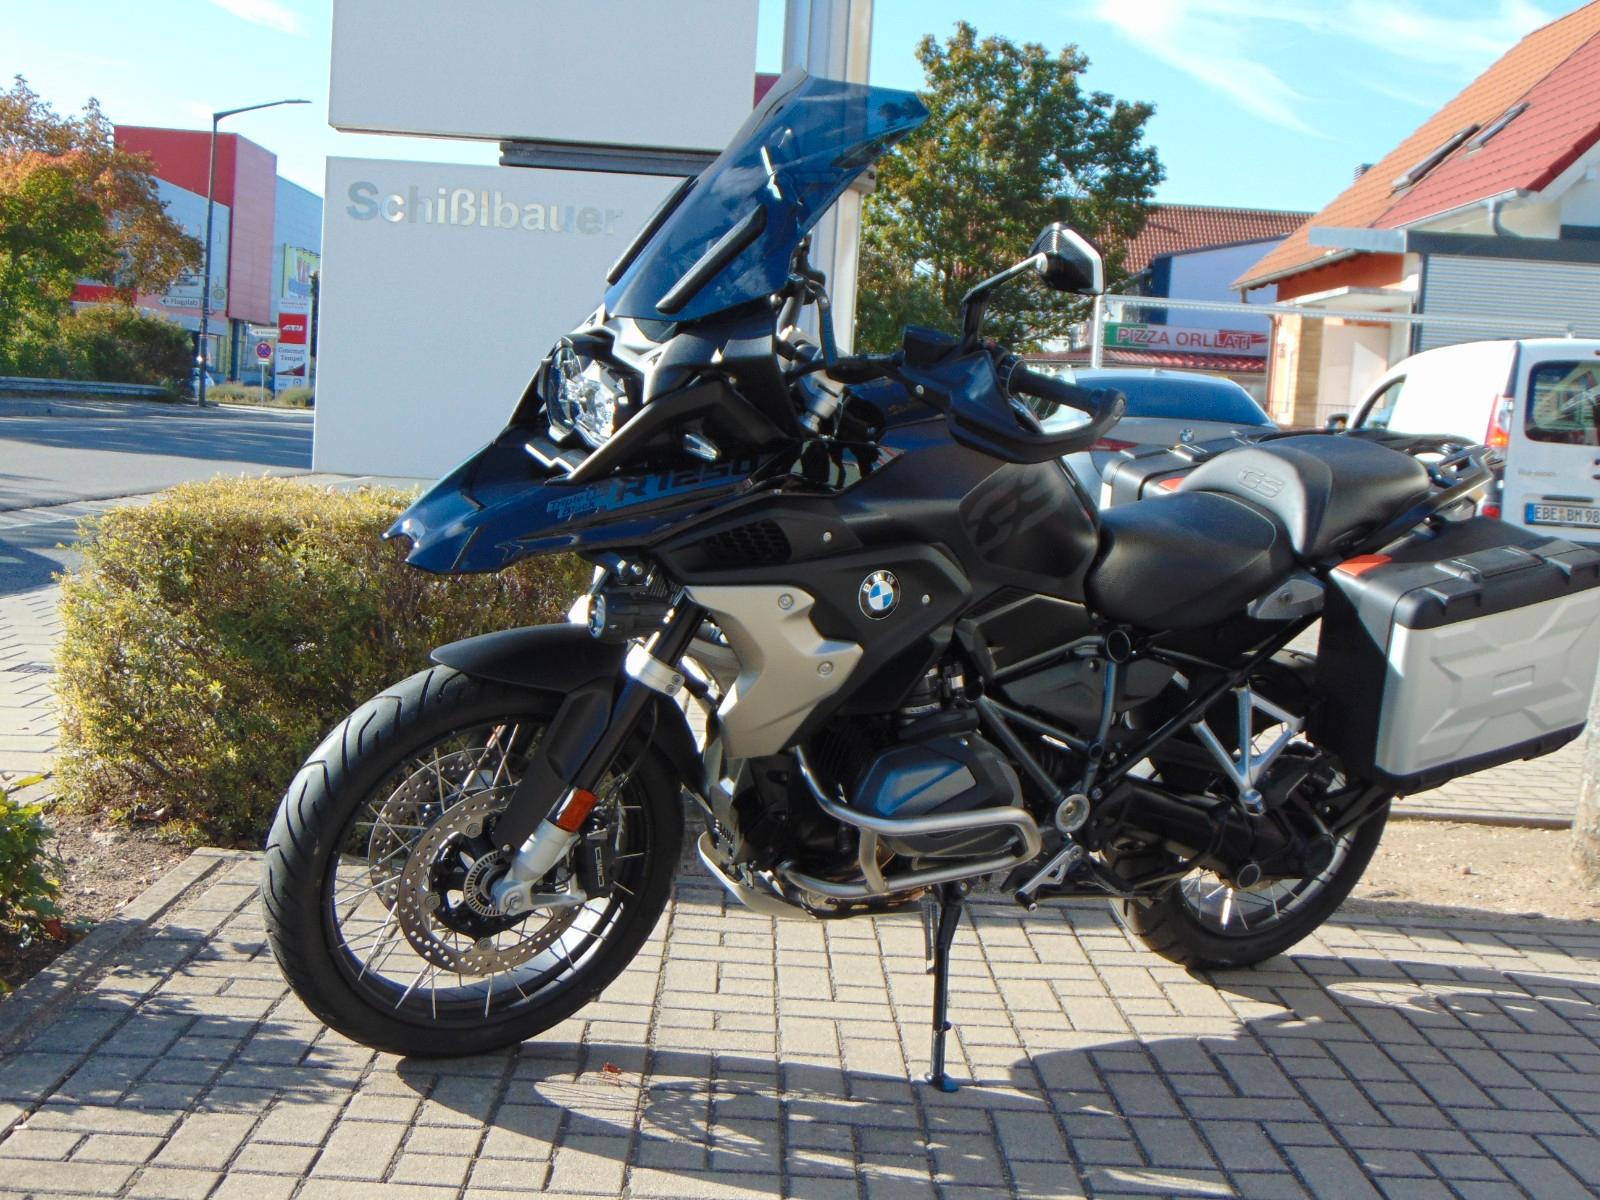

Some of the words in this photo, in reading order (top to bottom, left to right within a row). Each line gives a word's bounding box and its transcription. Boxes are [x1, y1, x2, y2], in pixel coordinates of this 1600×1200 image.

[346, 180, 624, 236] Schißlbauer
[1117, 328, 1170, 345] PIZZA
[1535, 506, 1558, 521] EBE
[863, 573, 895, 593] BMW
